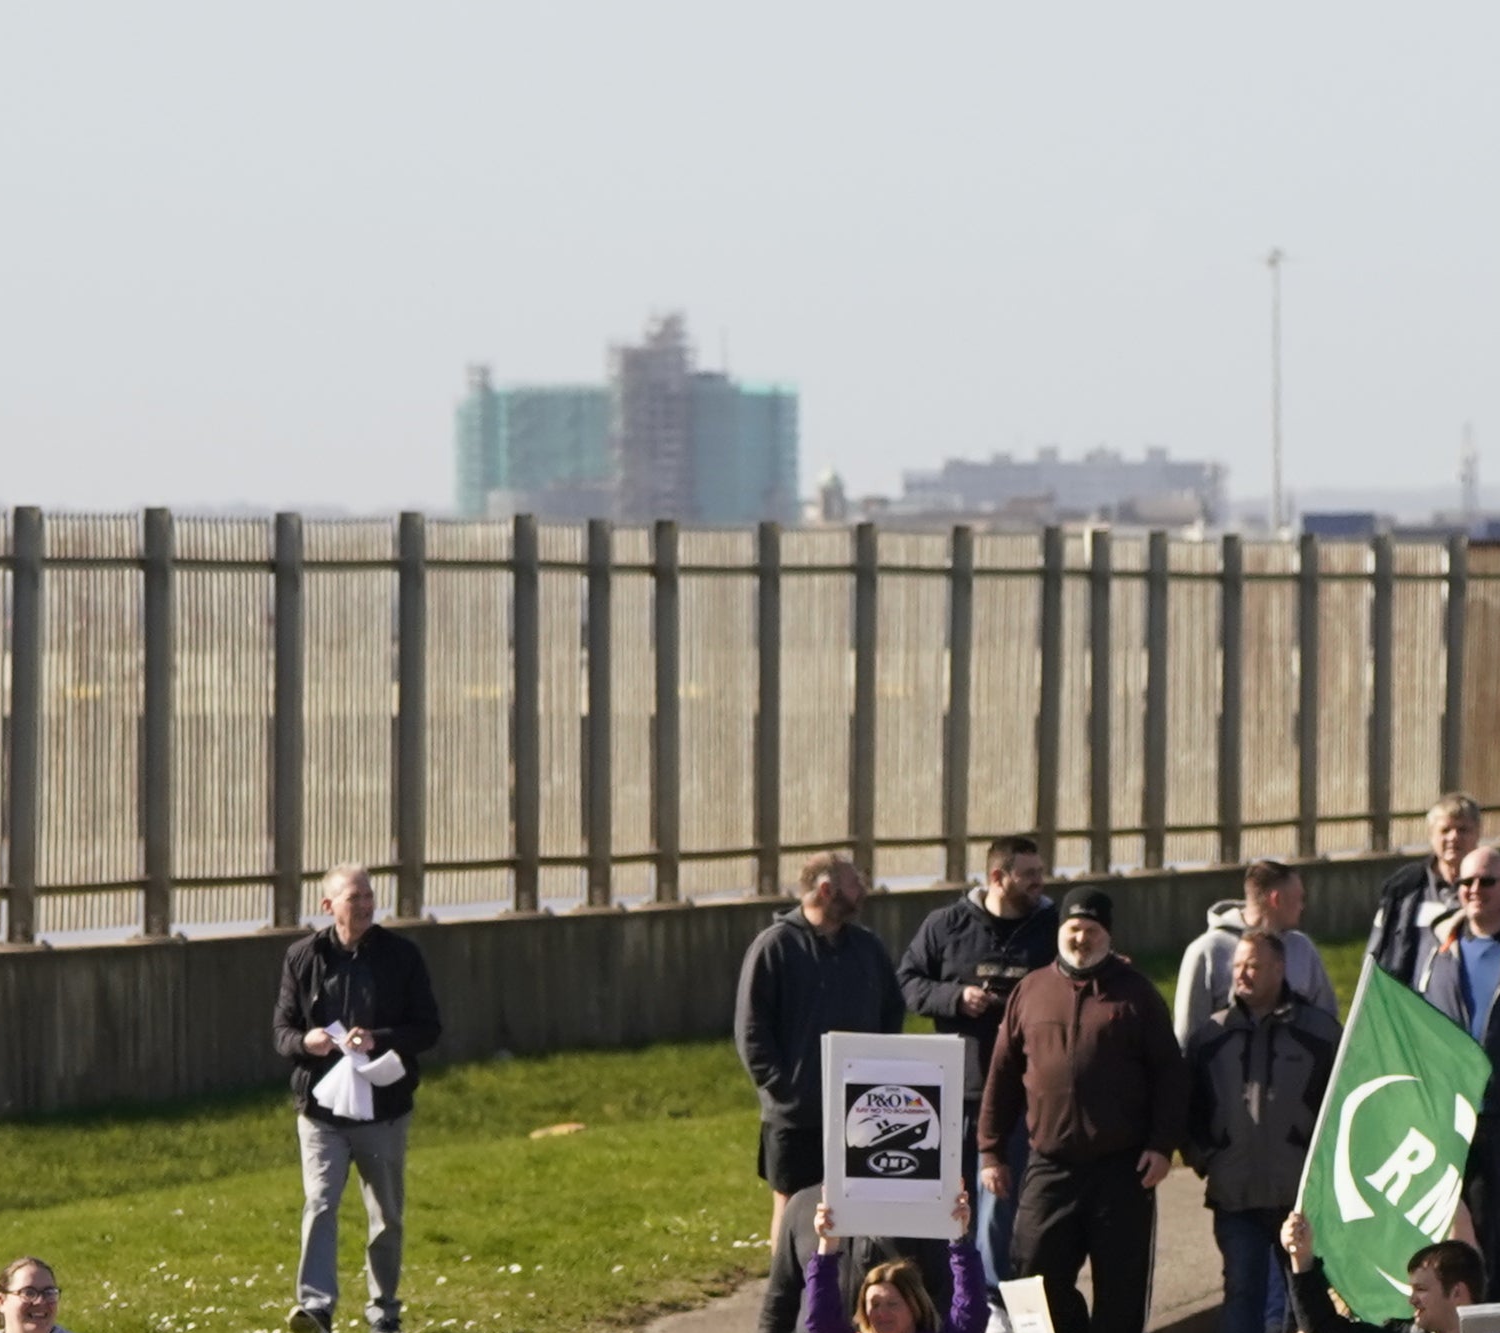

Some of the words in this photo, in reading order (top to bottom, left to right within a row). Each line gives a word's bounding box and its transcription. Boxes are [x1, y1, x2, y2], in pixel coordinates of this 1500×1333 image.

[866, 1093, 901, 1108] P&O
[880, 1156, 909, 1170] RMT
[1364, 1126, 1463, 1245] RM
